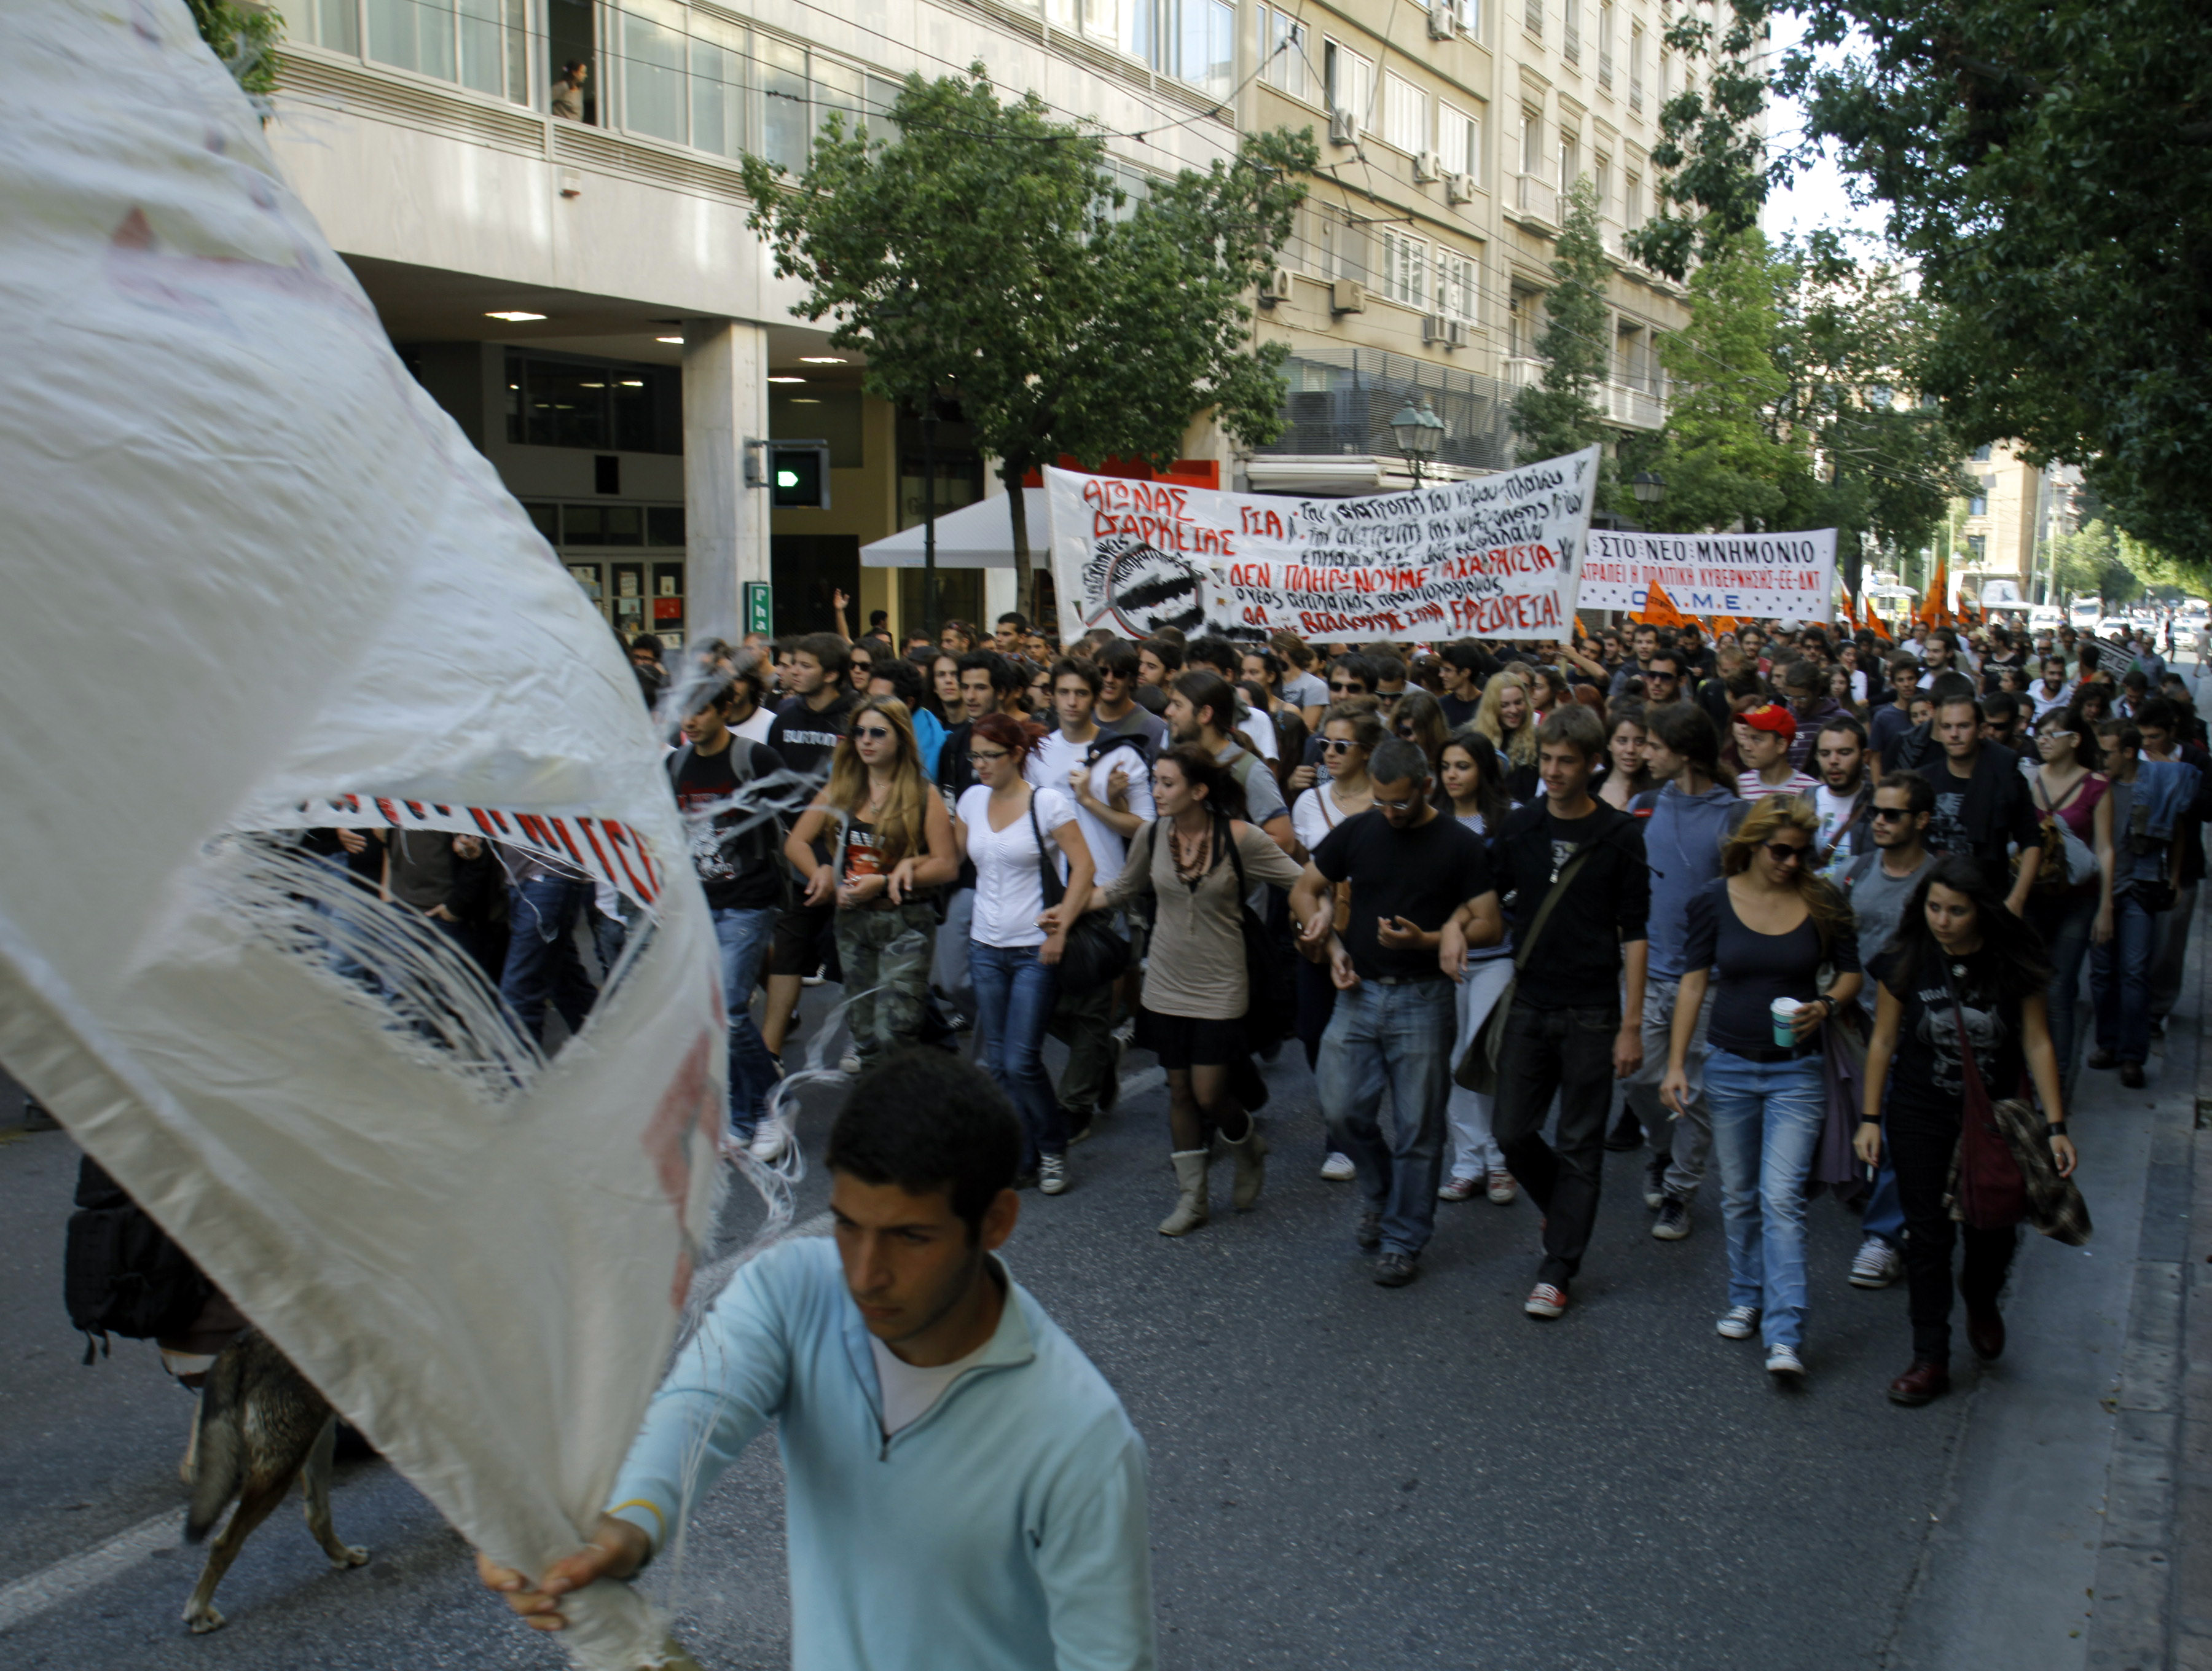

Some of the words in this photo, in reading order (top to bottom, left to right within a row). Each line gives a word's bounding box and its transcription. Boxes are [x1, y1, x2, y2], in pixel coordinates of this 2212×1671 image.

[1599, 536, 1636, 558] ΣΤΟ
[1644, 539, 1685, 562] ΝΕΟ
[1696, 540, 1814, 564] ΜΝΗΜΟΝΙΟ
[1231, 563, 1270, 588] ΔΕΝ
